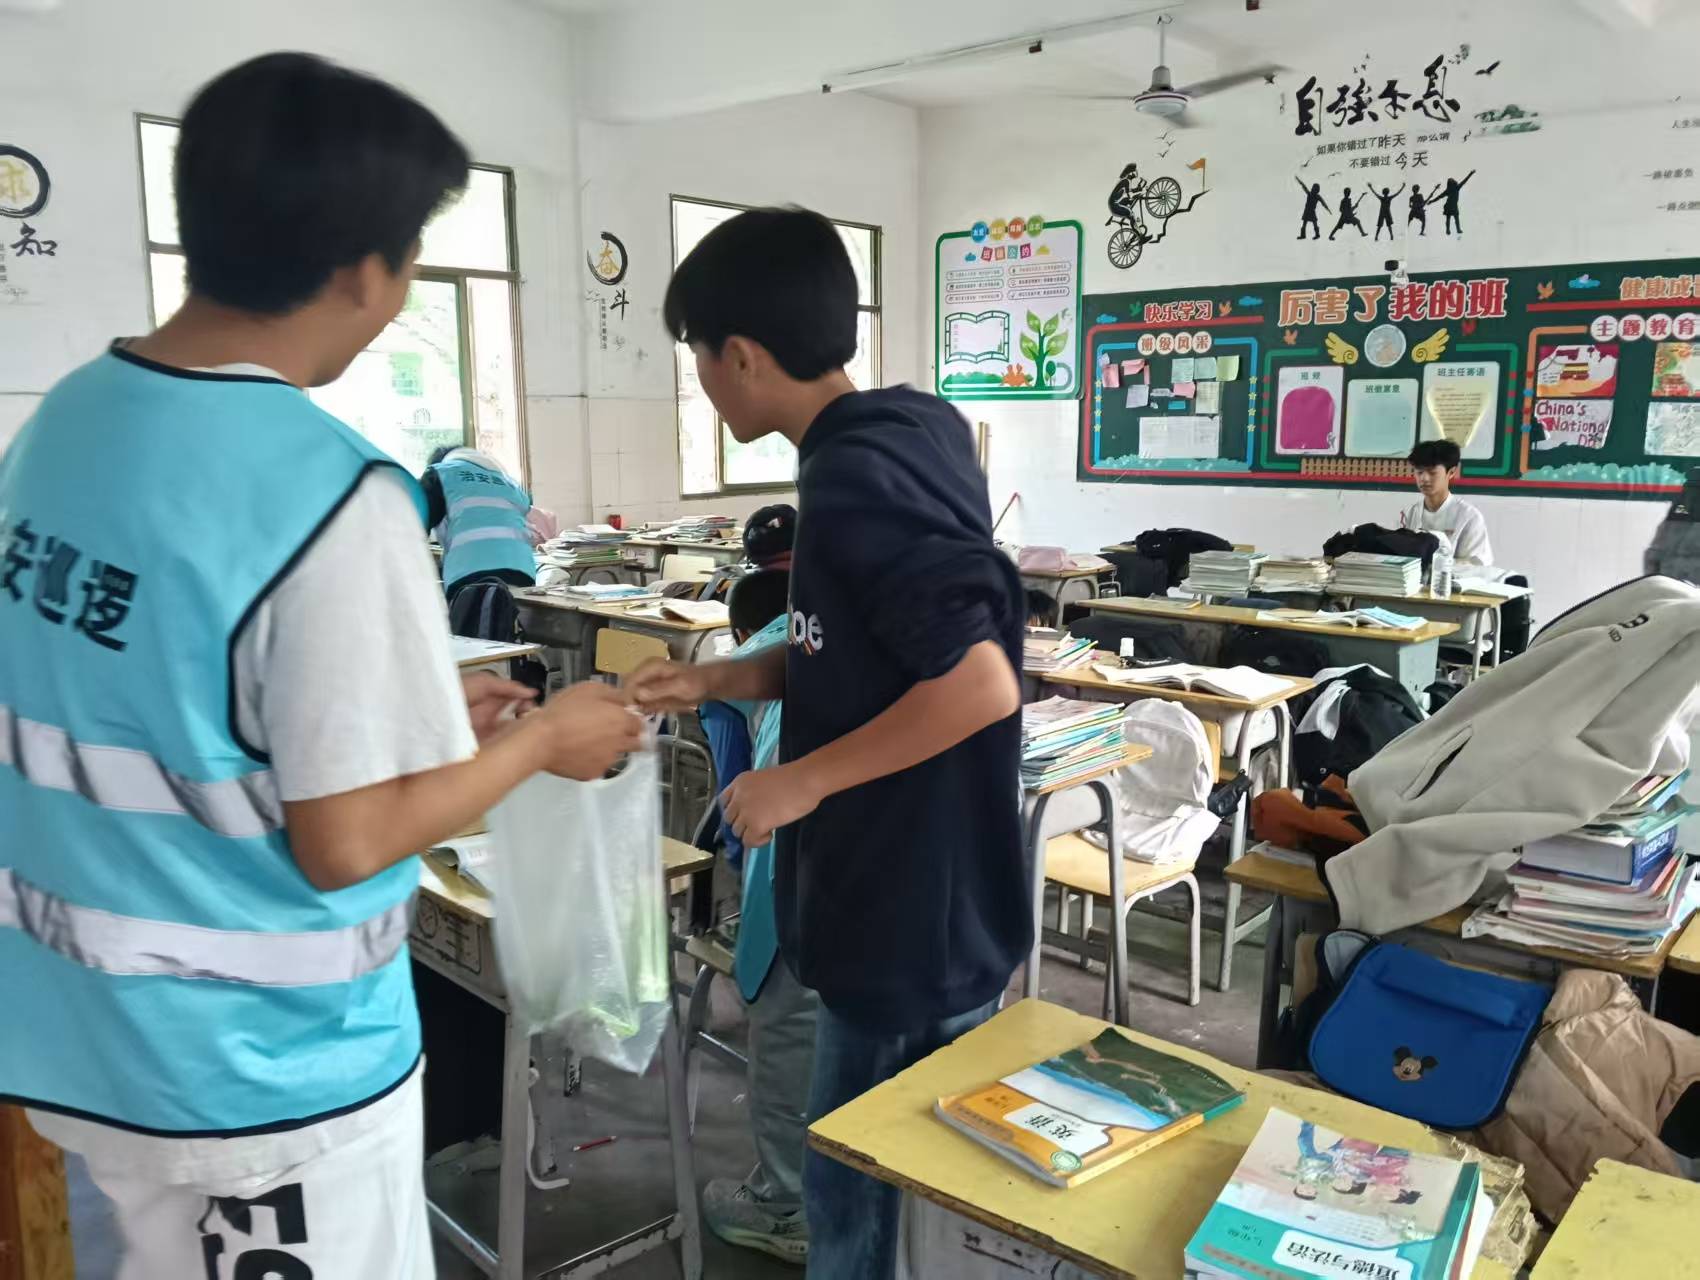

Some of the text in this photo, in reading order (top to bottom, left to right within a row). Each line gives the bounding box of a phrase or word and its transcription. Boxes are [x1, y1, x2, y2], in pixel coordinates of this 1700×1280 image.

[1316, 134, 1406, 155] 如果你错过了昨天
[1349, 151, 1428, 169] 不要错过今天
[1620, 275, 1700, 300] 健康成
[1145, 301, 1213, 322] 快乐学习
[1278, 278, 1508, 326] 厉害了我的班
[1596, 318, 1695, 337] 主题教育
[1536, 400, 1586, 416] China's
[1552, 416, 1608, 433] Nationa
